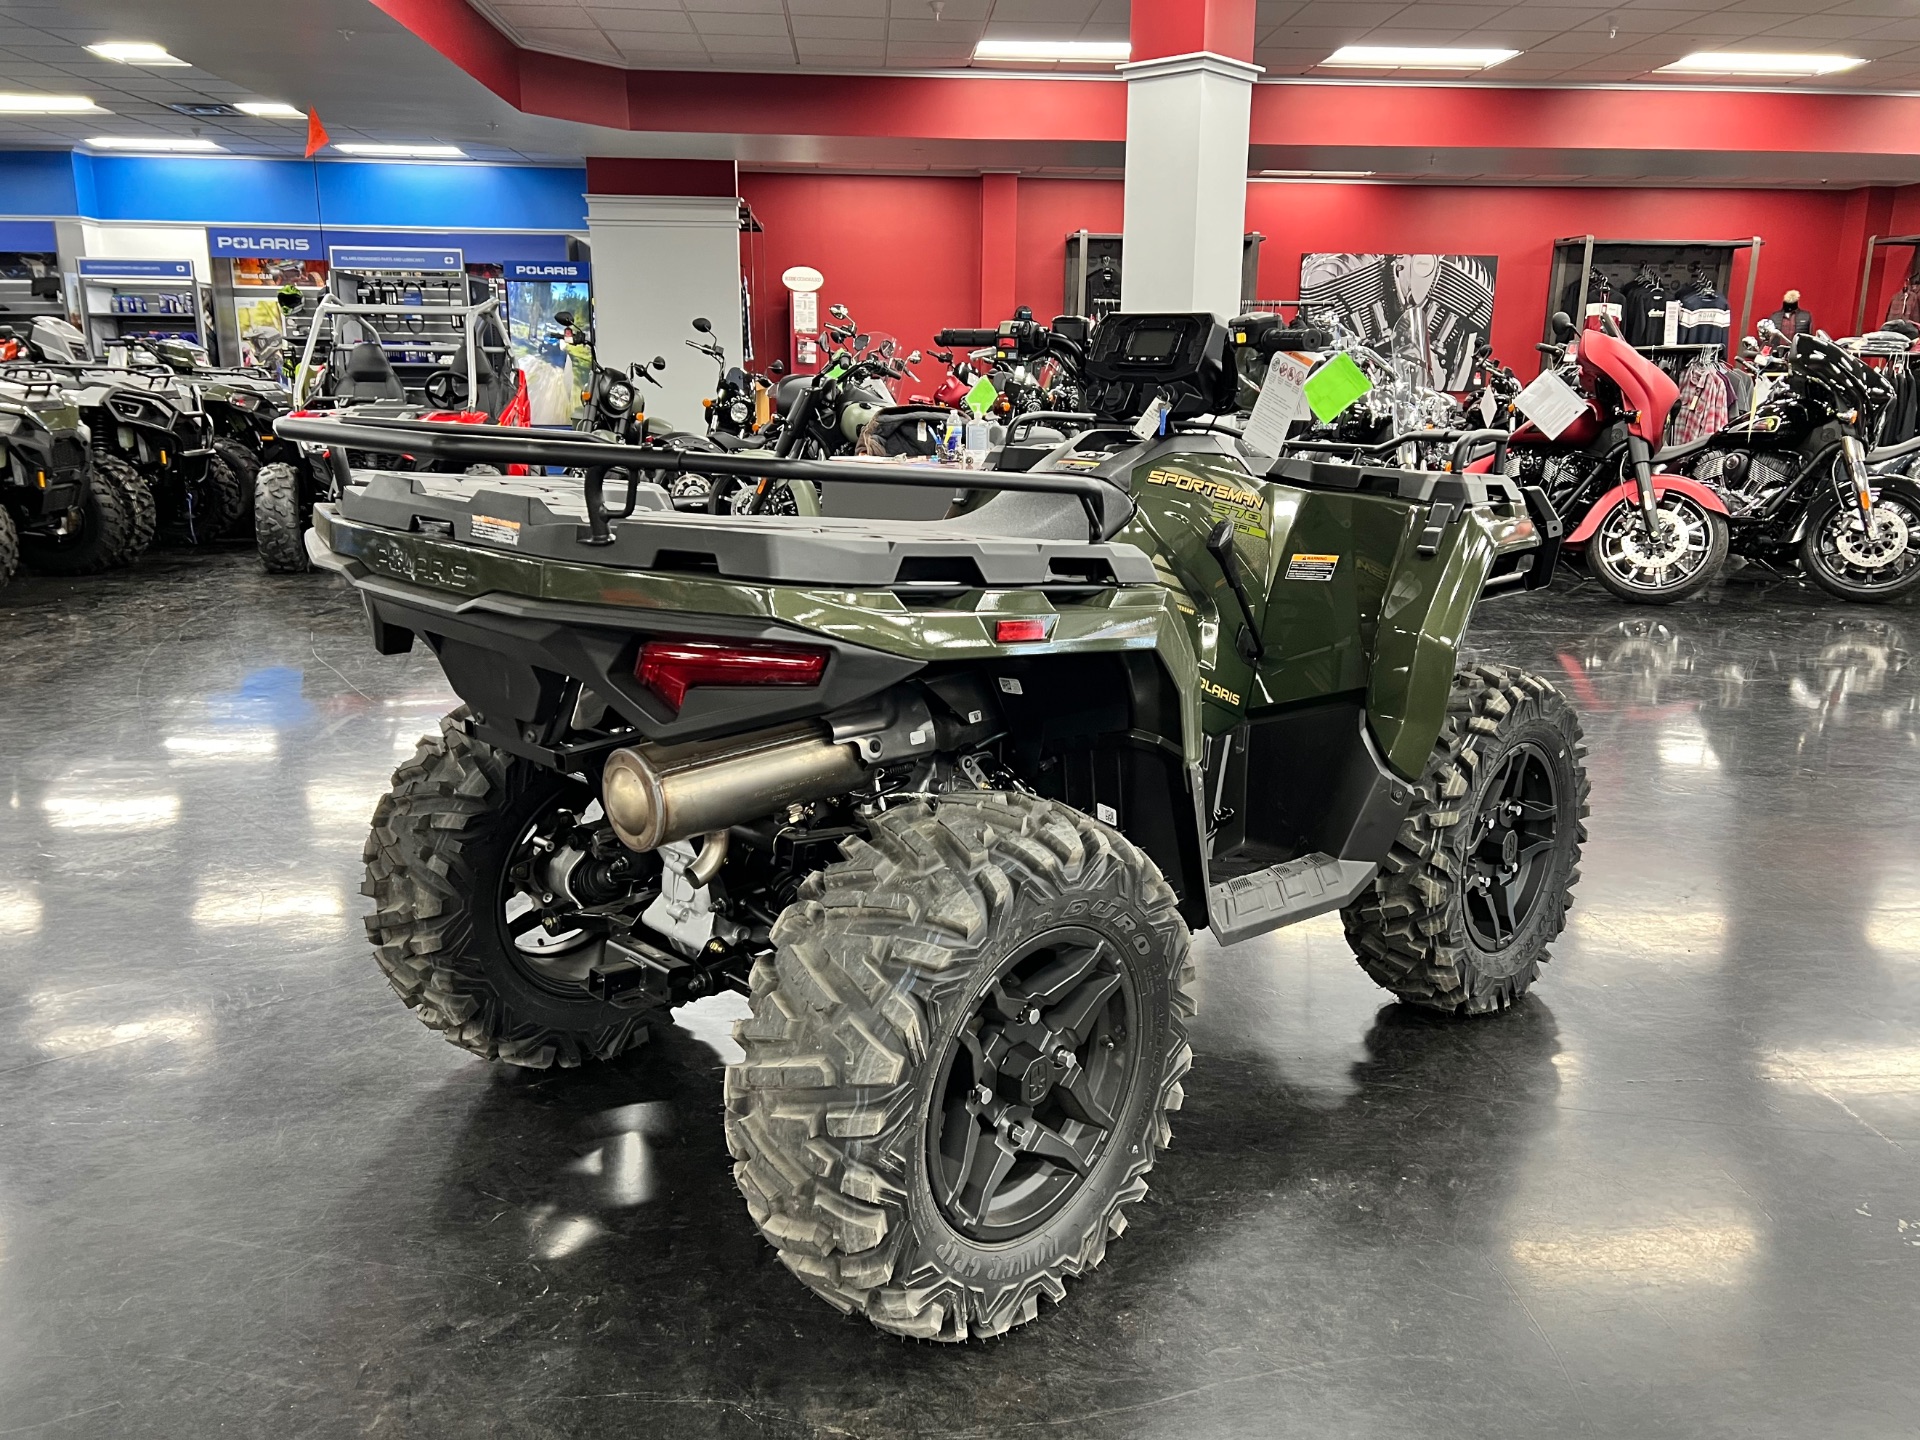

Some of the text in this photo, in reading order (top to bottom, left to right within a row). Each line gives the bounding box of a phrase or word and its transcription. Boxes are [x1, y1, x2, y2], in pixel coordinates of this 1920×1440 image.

[217, 236, 310, 251] POLARIS
[515, 265, 578, 276] POLARIS
[1147, 470, 1264, 510] SPORTSMAN
[1212, 502, 1263, 523] 570
[1200, 676, 1240, 706] OLARIS
[1059, 899, 1151, 956] DURO
